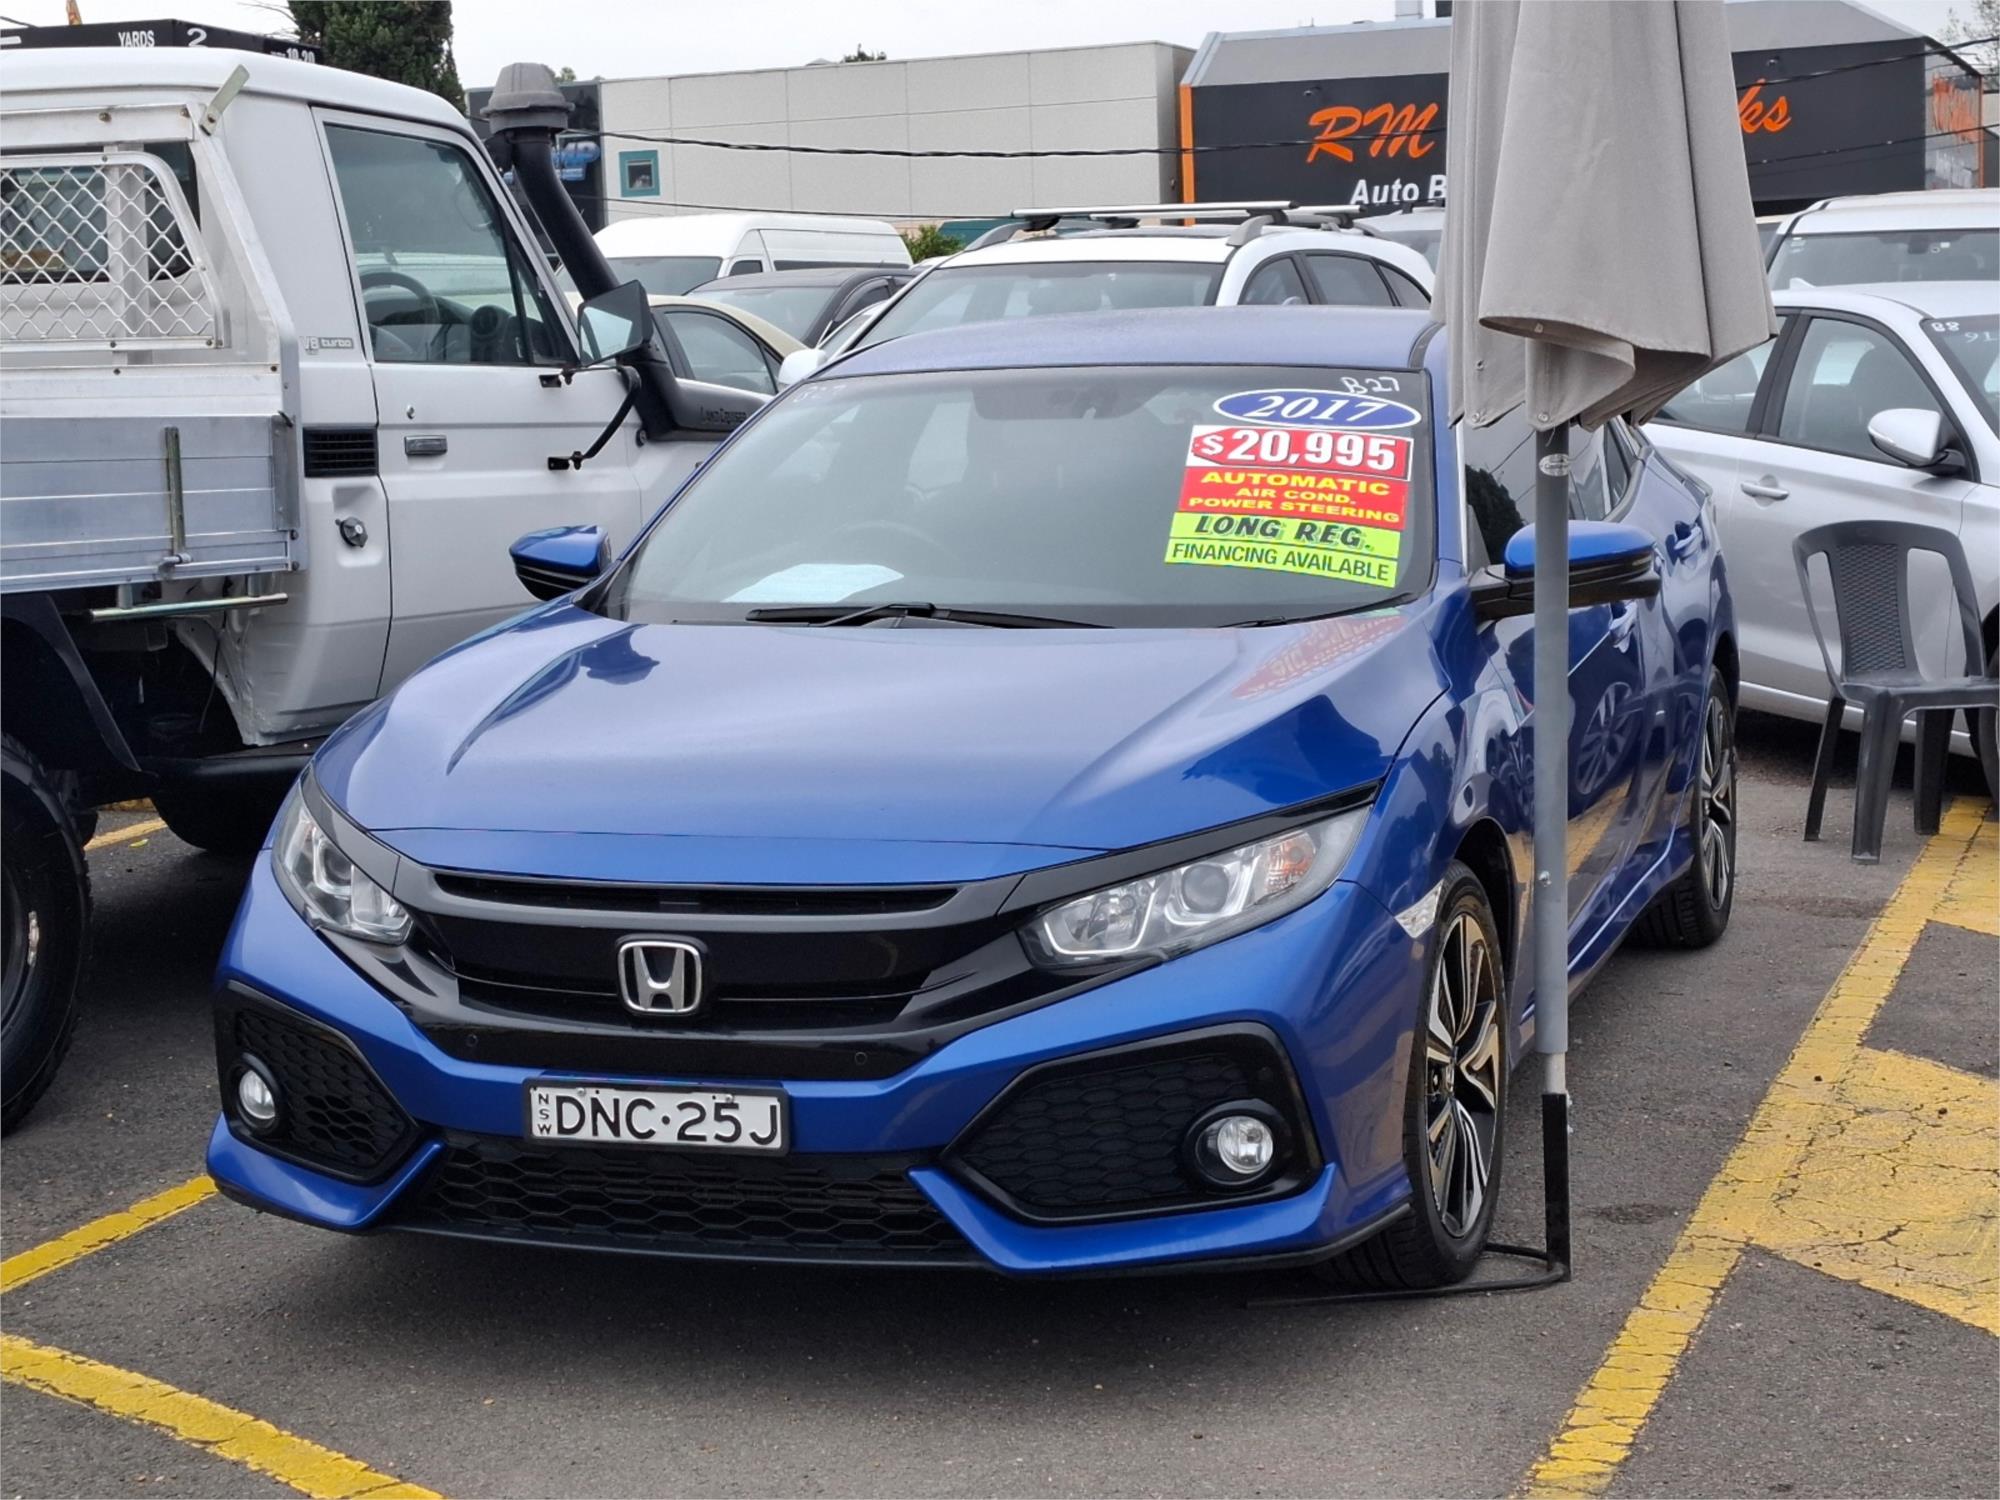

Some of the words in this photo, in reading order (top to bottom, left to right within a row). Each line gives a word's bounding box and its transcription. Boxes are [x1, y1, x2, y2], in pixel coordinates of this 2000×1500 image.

[118, 30, 155, 47] YARDS
[187, 28, 207, 47] 2
[1306, 102, 1440, 163] RM
[1738, 78, 1792, 133] ks
[1350, 178, 1420, 205] Auto
[1428, 174, 1447, 203] B
[1341, 376, 1400, 395] B27
[1243, 395, 1388, 422] 2017
[1200, 429, 1396, 471] $20,995
[1200, 470, 1391, 496] AUTOMATIC
[1235, 487, 1278, 498] AIR
[1283, 490, 1357, 505] COND.
[1188, 497, 1273, 510] POWER
[1279, 501, 1400, 523] STEERING
[1194, 514, 1283, 539] LONG
[1293, 521, 1375, 552] REG.
[1172, 543, 1278, 566] FINANCING
[1283, 551, 1390, 582] AVAILABLE
